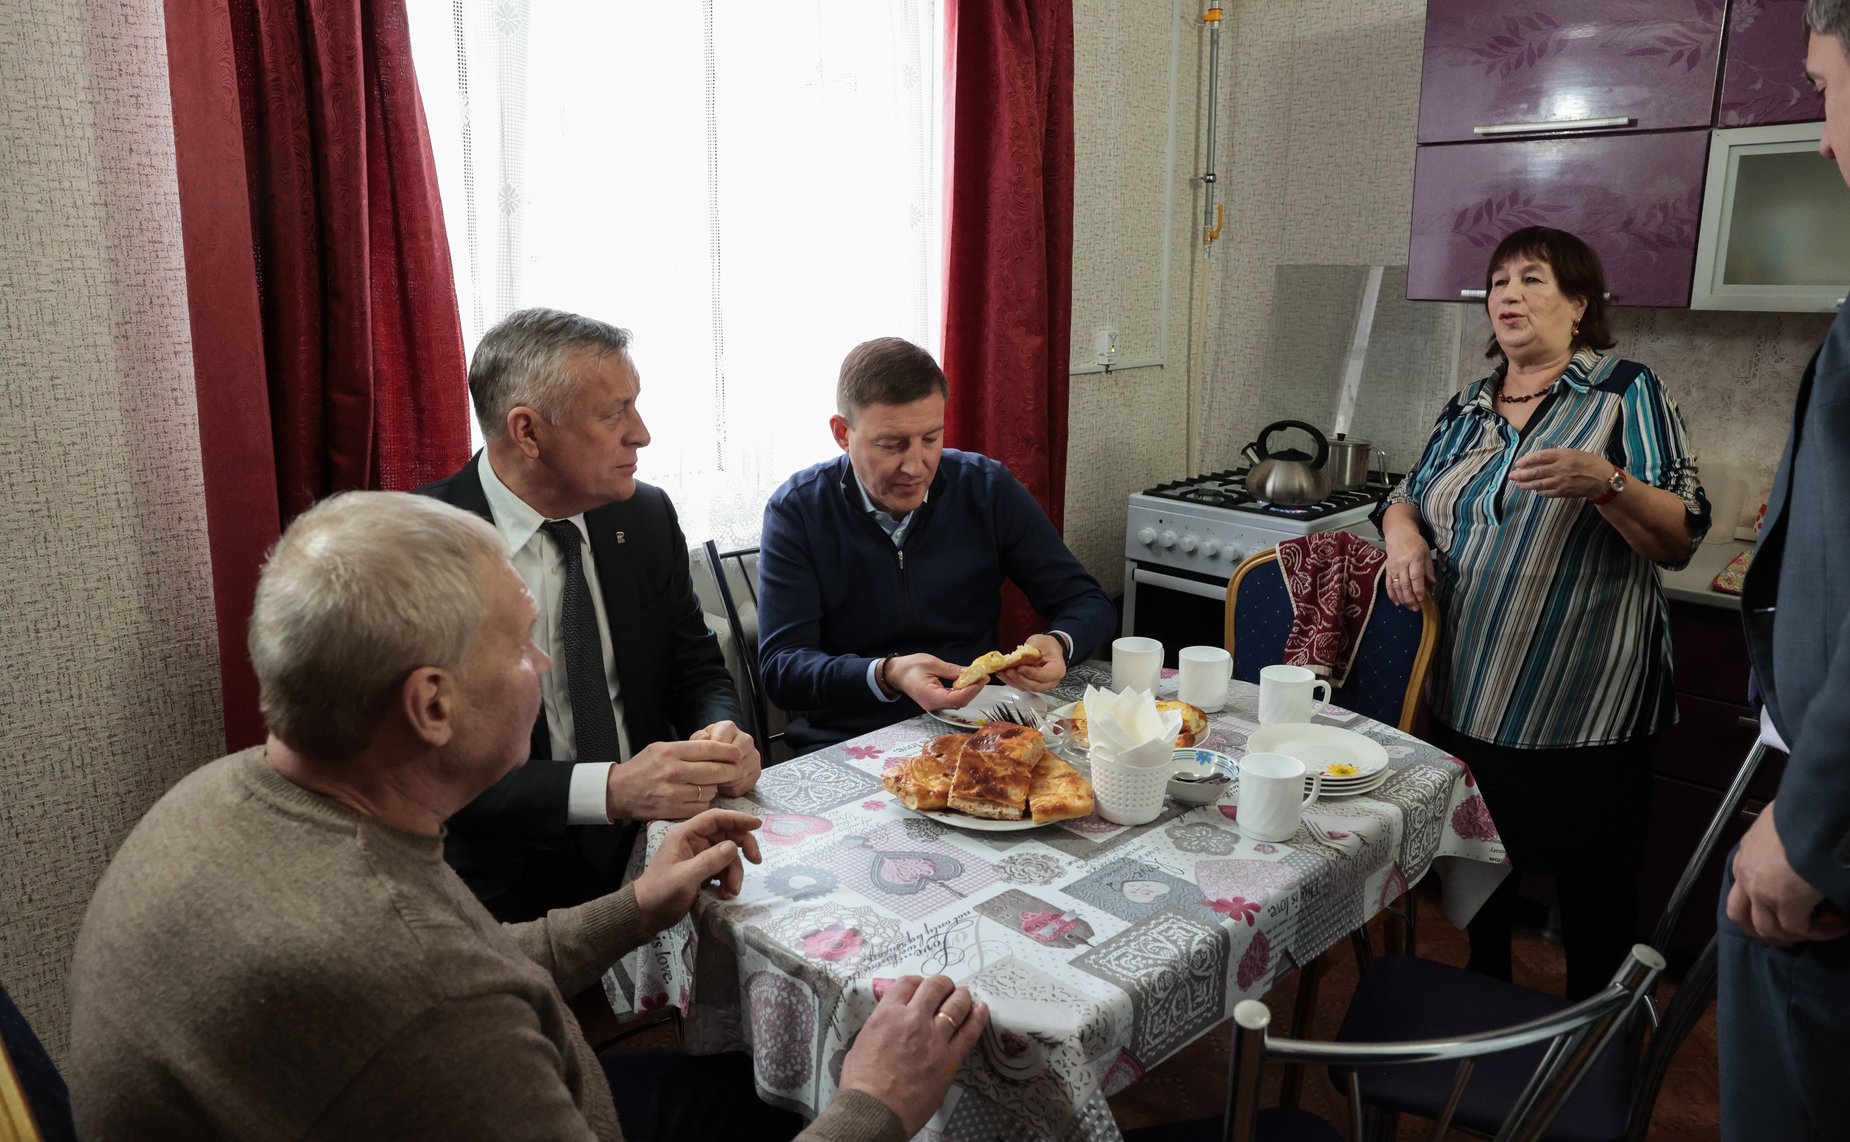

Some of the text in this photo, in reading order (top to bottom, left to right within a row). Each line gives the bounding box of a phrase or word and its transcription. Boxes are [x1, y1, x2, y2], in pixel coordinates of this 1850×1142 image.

[1267, 897, 1289, 918] love.
[1291, 892, 1299, 908] is
[924, 918, 951, 936] only
[951, 910, 971, 927] not
[906, 931, 924, 945] by
[654, 951, 673, 985] love.
